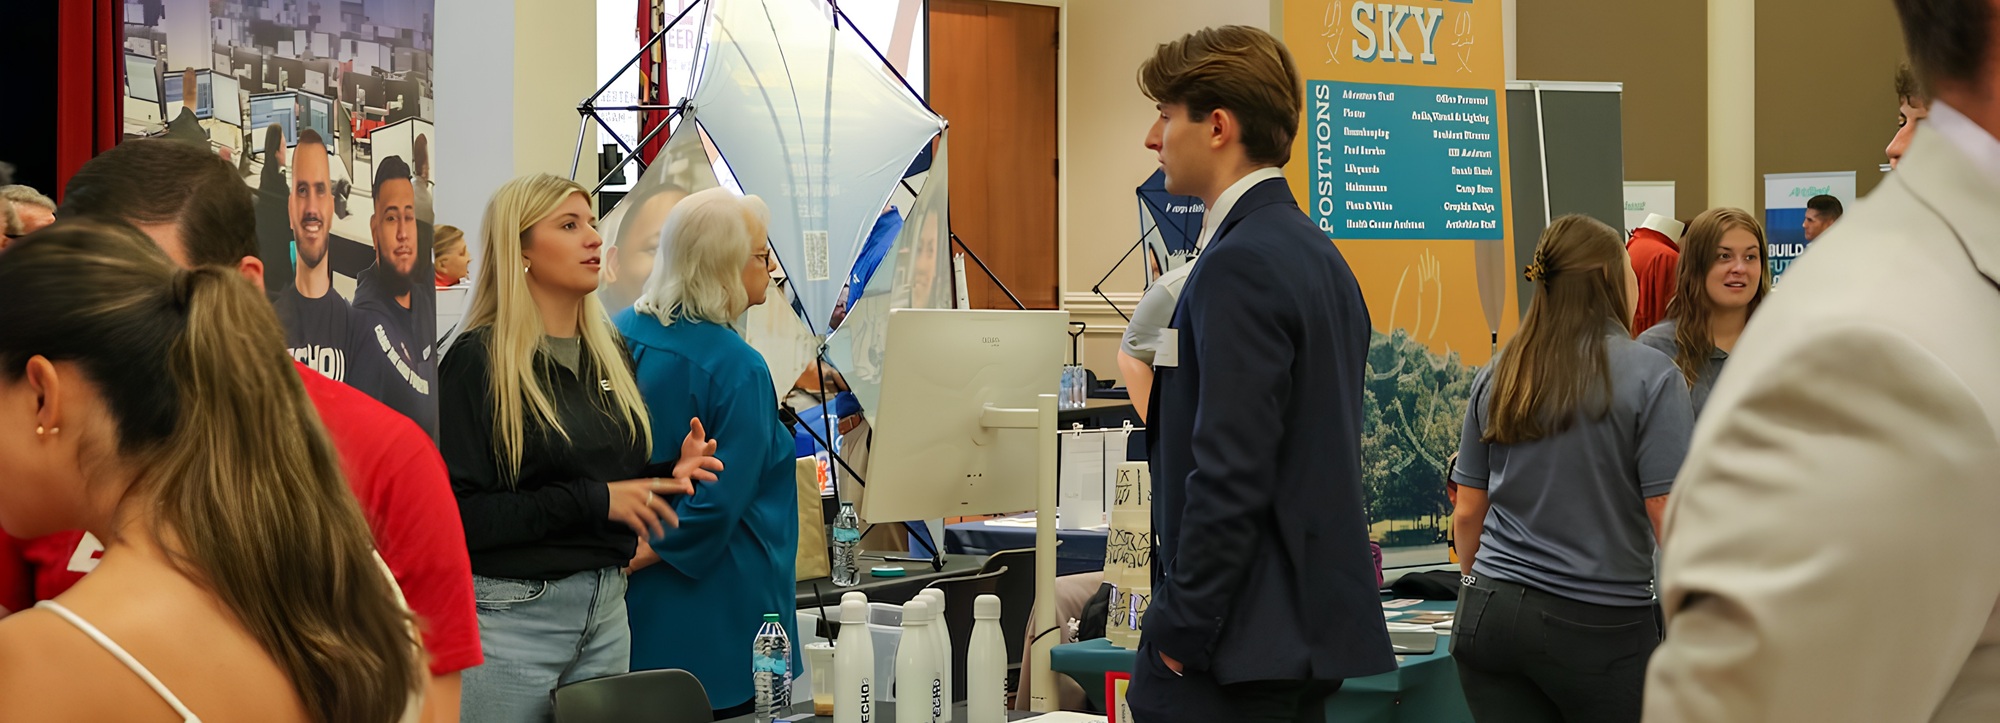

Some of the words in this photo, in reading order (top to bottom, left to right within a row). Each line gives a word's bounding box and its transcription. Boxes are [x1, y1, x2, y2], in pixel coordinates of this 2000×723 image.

[1351, 1, 1444, 64] SKY
[1315, 84, 1334, 234] POSITIONS
[1768, 244, 1804, 257] BUILD
